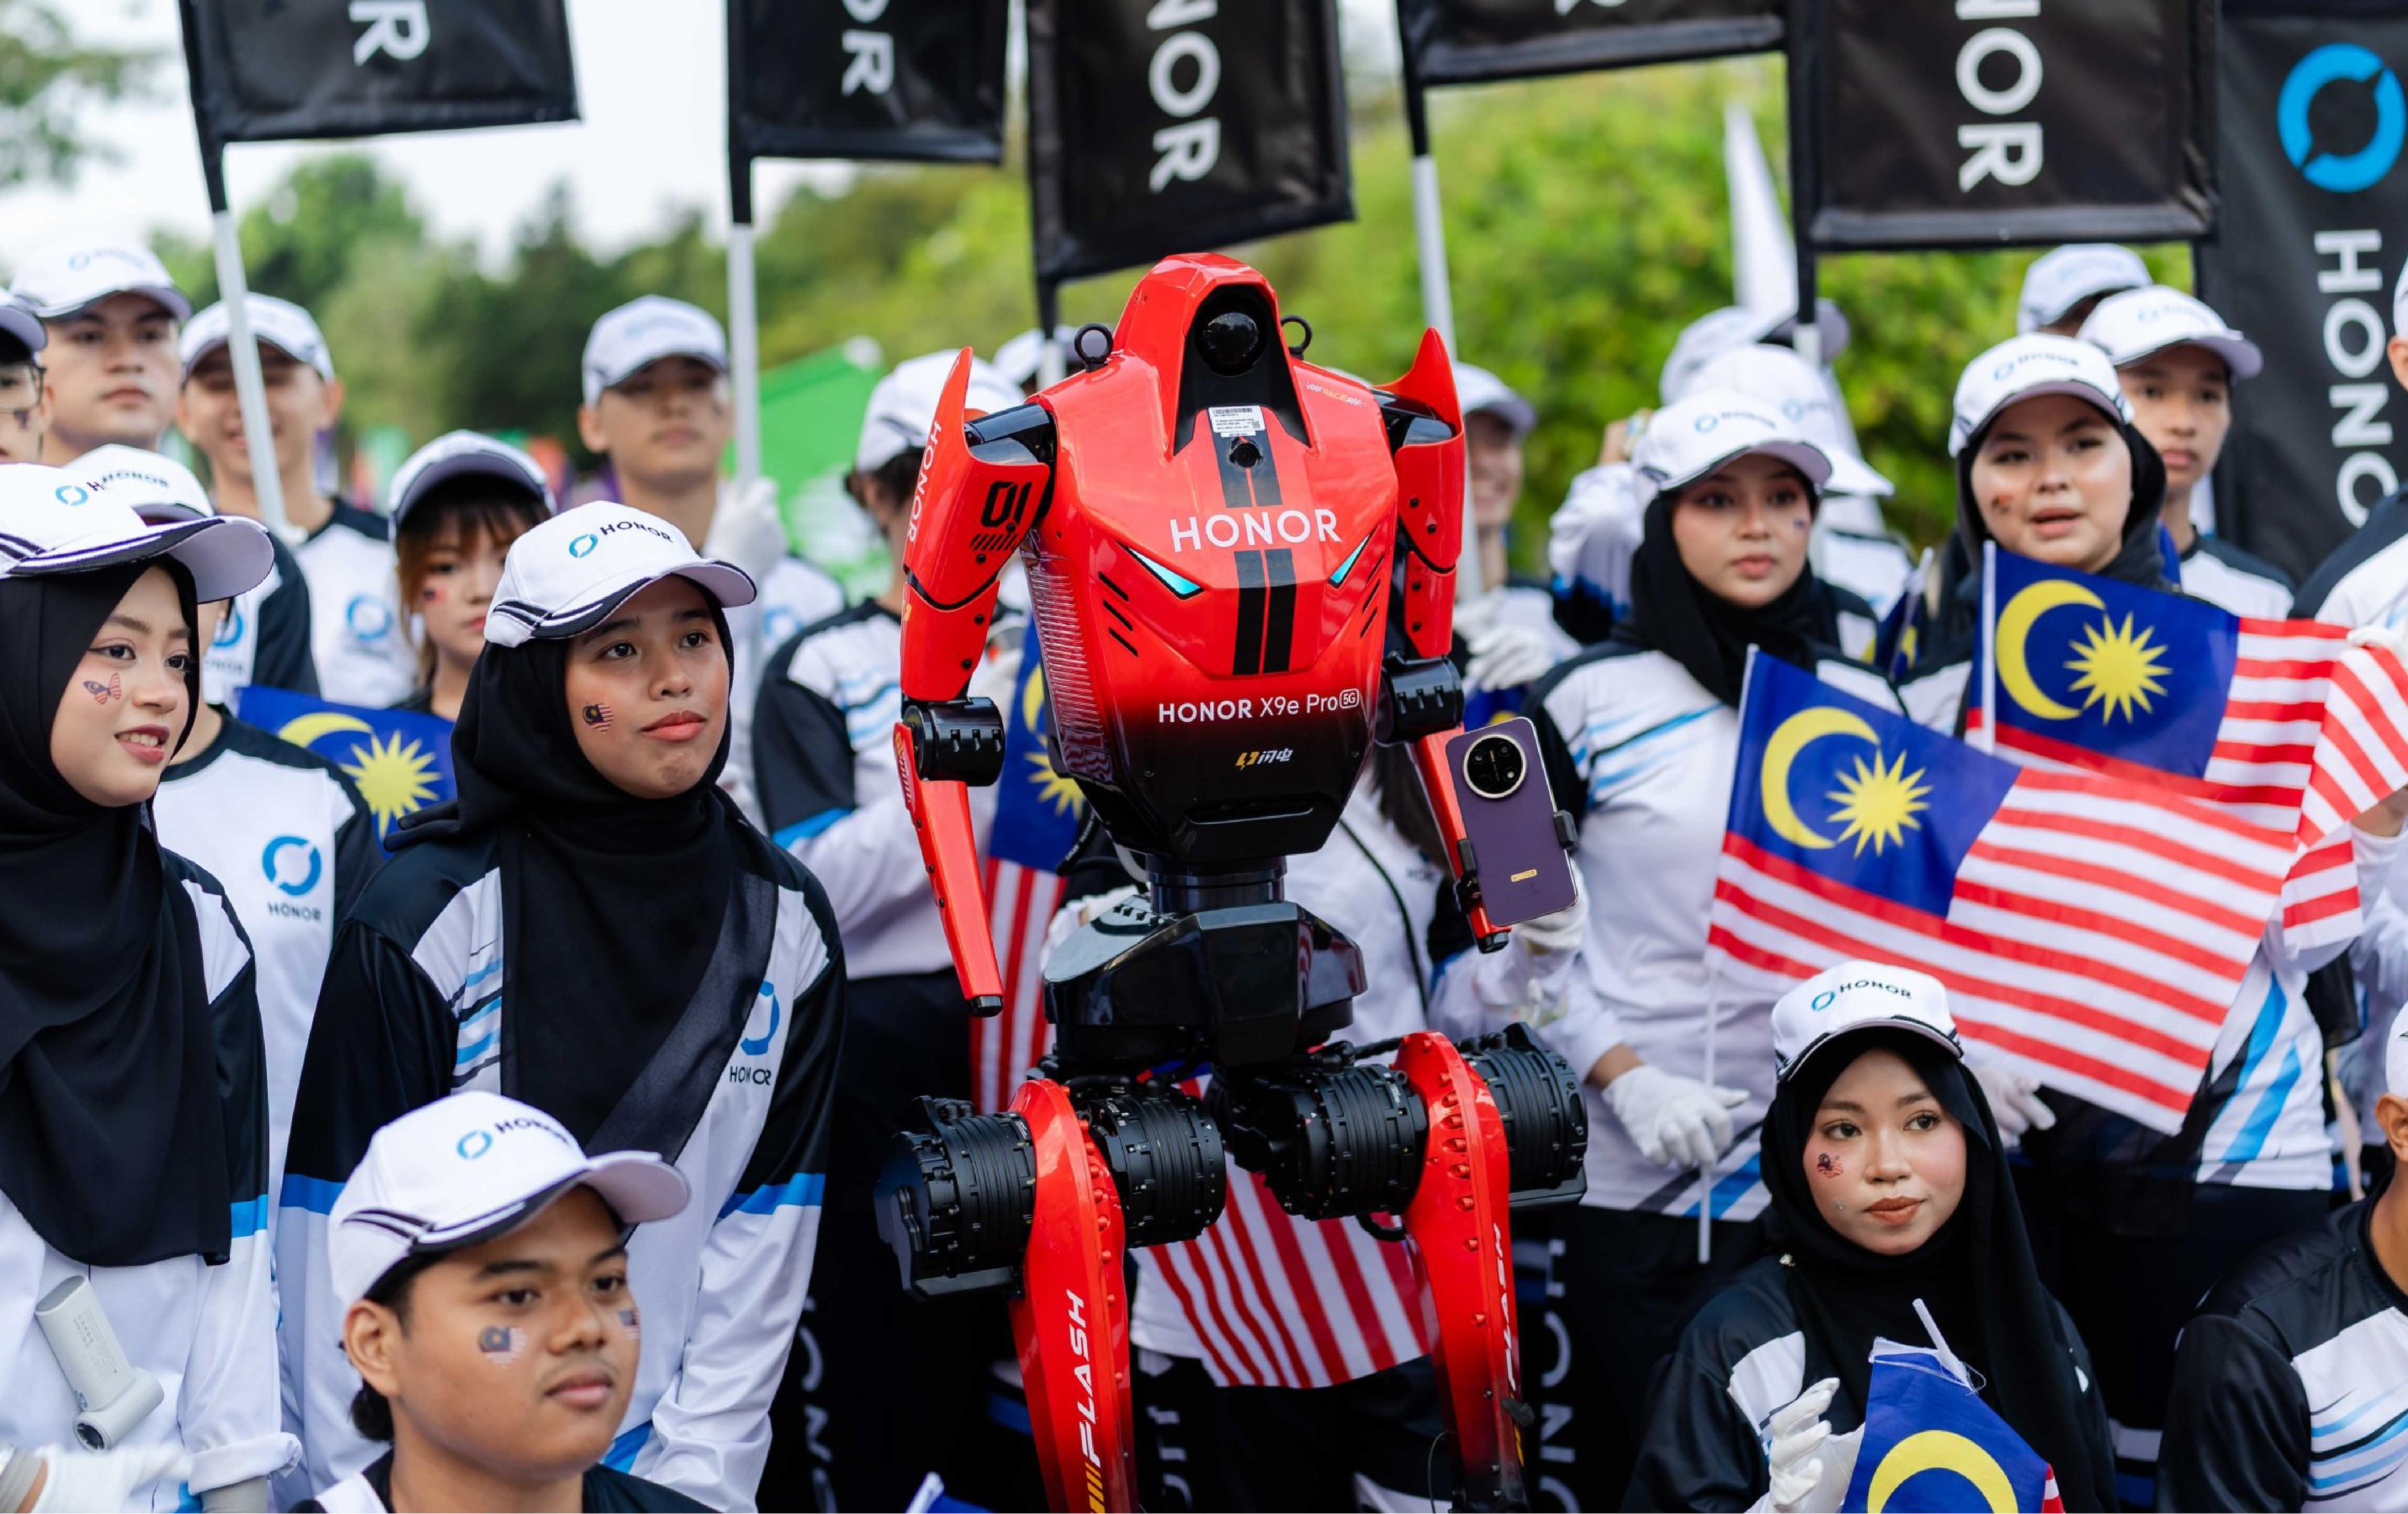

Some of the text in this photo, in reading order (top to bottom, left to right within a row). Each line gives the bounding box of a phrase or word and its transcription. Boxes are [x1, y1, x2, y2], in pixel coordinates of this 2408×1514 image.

[1955, 0, 2044, 193] OR
[909, 421, 942, 542] HONOR
[599, 521, 674, 544] HONOR
[1170, 508, 1343, 552] HONOR
[1159, 693, 1253, 723] HONOR
[1260, 690, 1299, 717] X9e
[1306, 693, 1338, 713] Pro
[267, 902, 321, 922] HONOR
[1839, 980, 1911, 999] HONOR
[729, 1066, 772, 1085] HONOR
[1066, 1288, 1101, 1468] FLASH
